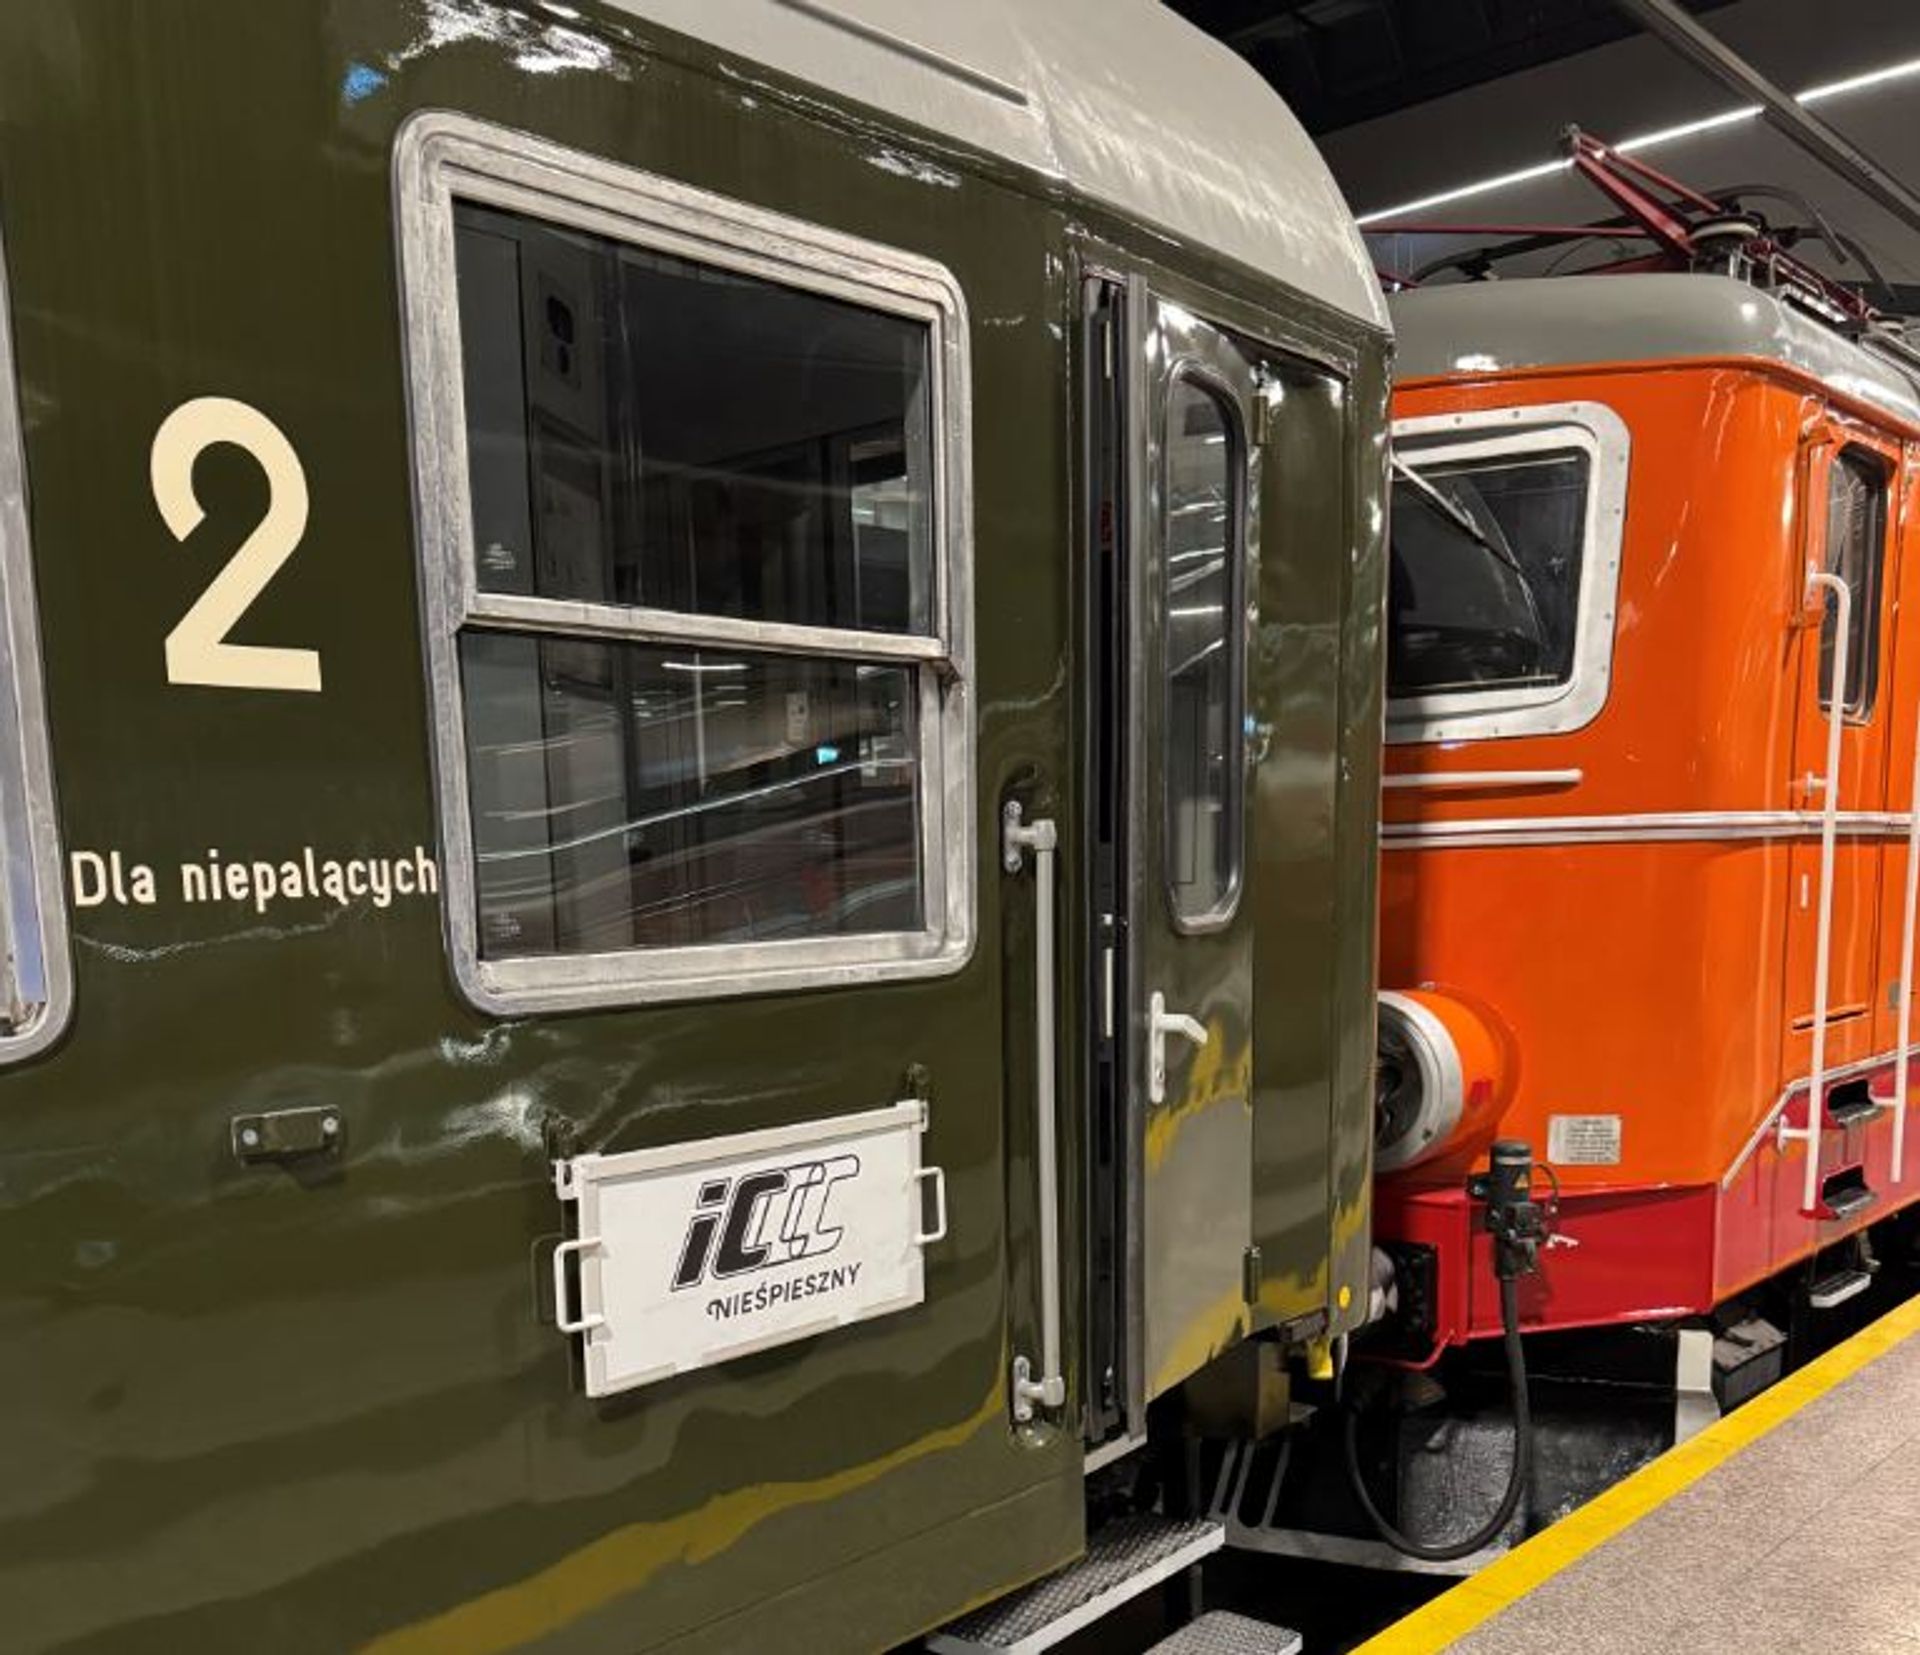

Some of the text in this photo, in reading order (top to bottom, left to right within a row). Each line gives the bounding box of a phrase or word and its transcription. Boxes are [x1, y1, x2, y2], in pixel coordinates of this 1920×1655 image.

[150, 396, 322, 692] 2
[70, 845, 440, 913] Dla niepalących
[706, 1262, 862, 1321] NIEŚPIESZNY
